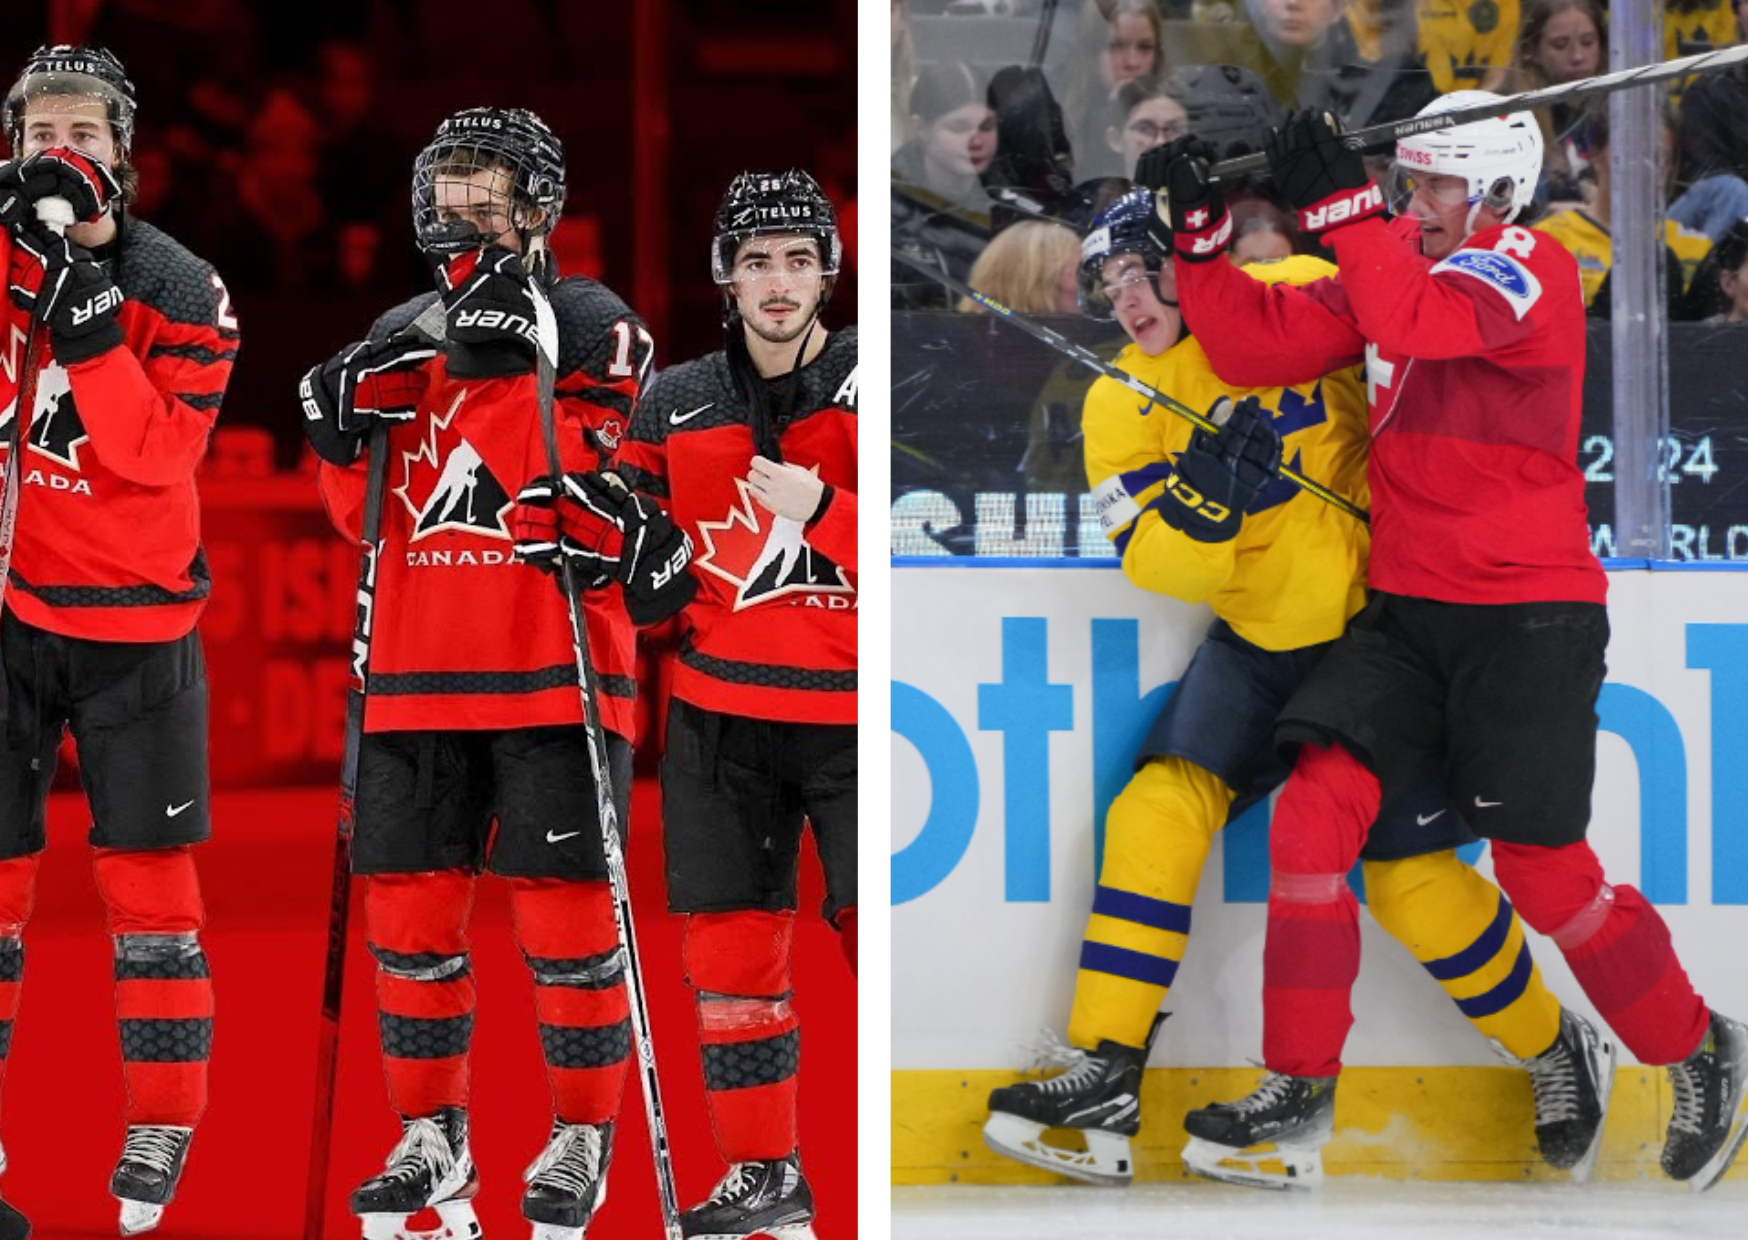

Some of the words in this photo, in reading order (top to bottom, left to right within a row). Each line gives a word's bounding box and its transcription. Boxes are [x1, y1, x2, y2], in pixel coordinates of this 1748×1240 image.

[46, 60, 96, 73] TELUS
[454, 116, 502, 130] TELUS
[759, 204, 812, 219] TELUS
[1459, 255, 1518, 286] Ford
[1583, 435, 1719, 484] 224
[1588, 524, 1748, 561] WRLD
